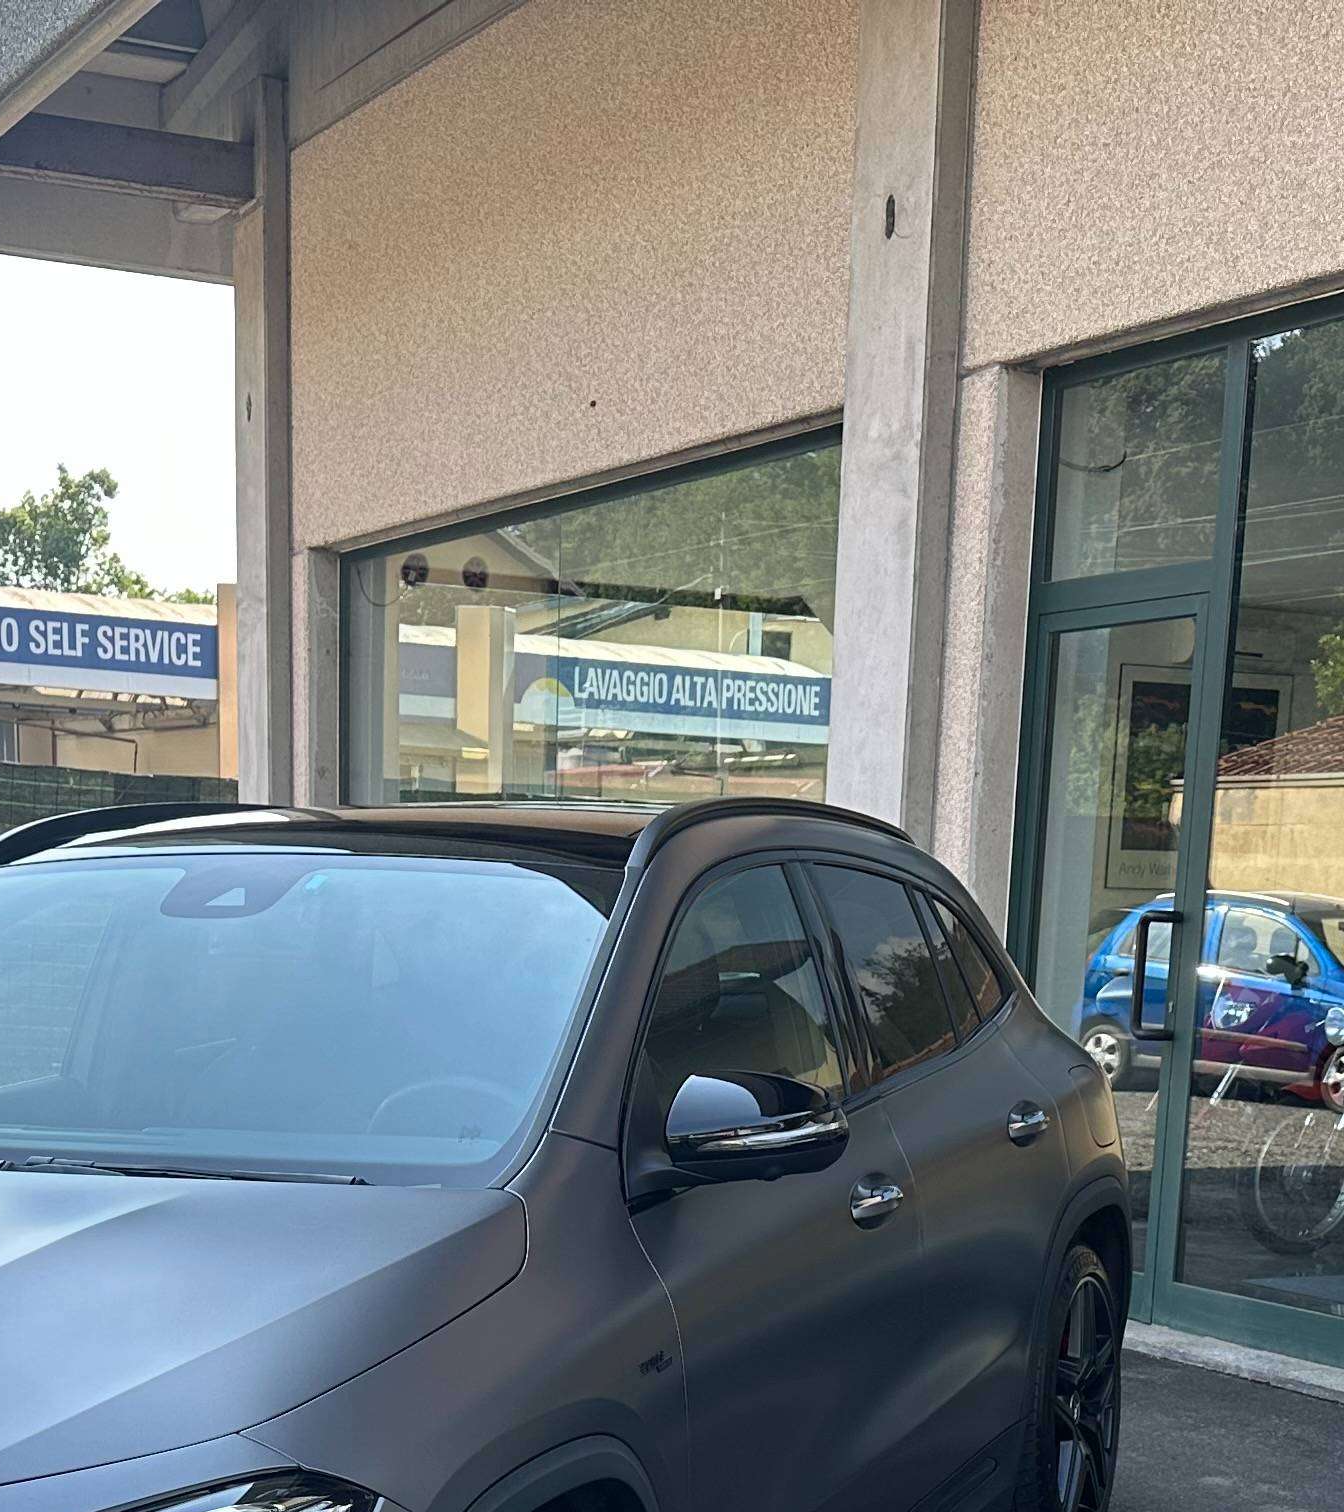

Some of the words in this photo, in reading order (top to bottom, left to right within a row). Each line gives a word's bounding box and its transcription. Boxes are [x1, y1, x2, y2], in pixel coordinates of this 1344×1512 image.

[29, 619, 89, 658] SELF
[96, 625, 202, 668] SERVICE
[574, 666, 668, 704] LAVAGGIO
[671, 674, 718, 708] ALTA
[720, 678, 821, 717] PRESSIONE
